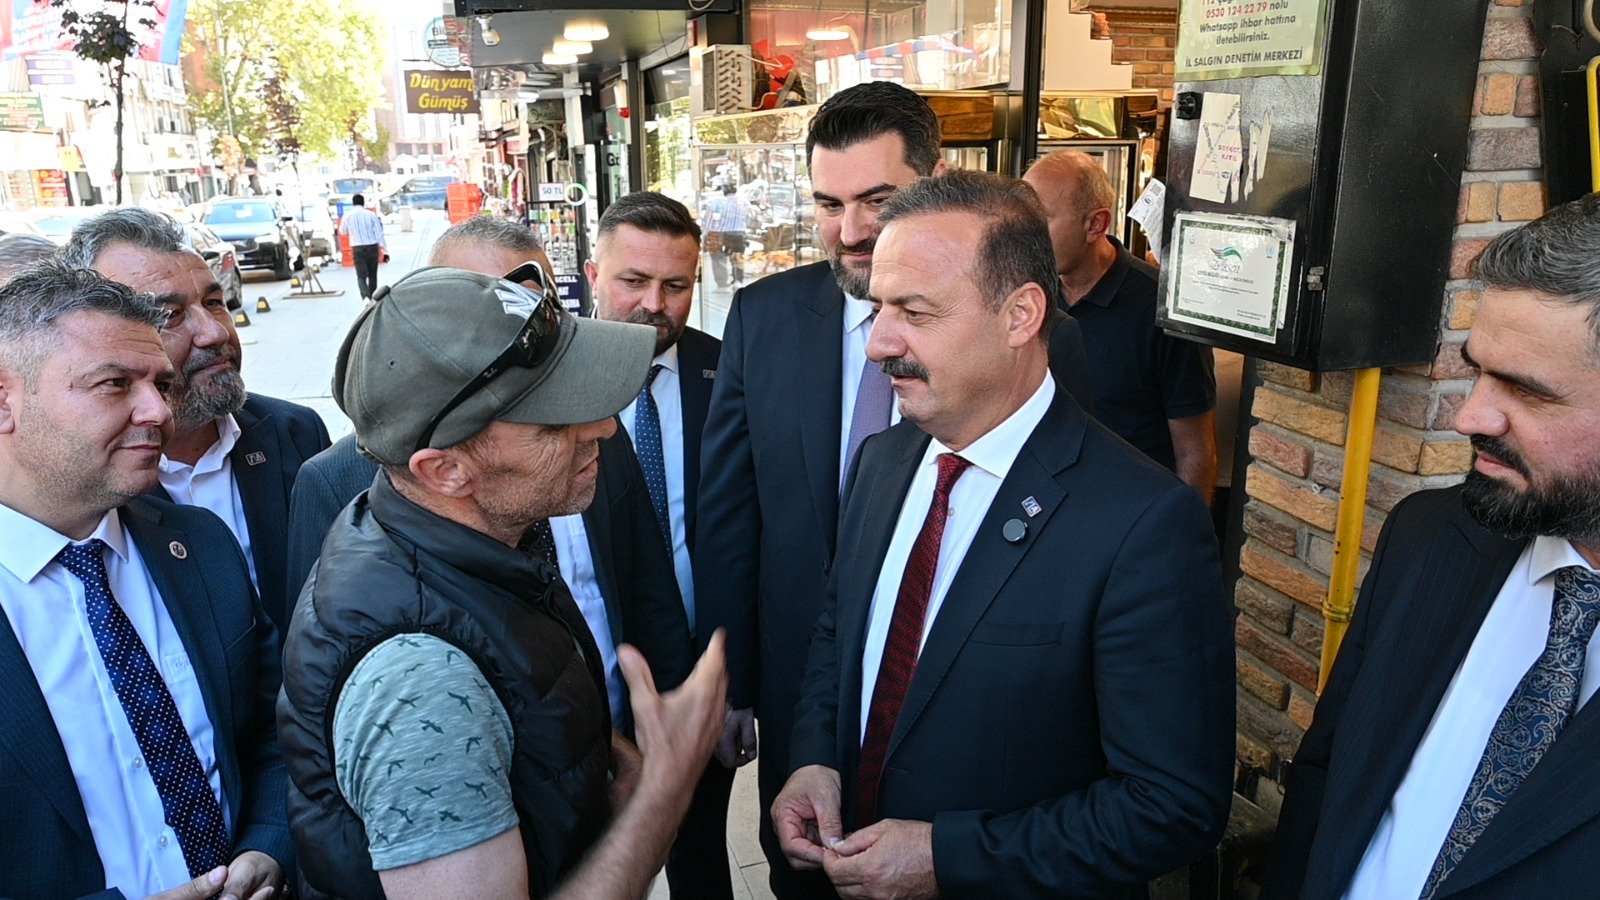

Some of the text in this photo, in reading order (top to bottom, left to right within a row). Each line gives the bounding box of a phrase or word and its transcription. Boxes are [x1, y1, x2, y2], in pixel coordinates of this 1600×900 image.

[1206, 0, 1289, 19] 0530 124 22 79 nolu
[1200, 14, 1296, 34] Whatsapp ihbar hattına
[1186, 46, 1303, 67] İL SALGIN DENETİM MERKEZİ
[419, 93, 468, 111] Gümüş
[542, 187, 552, 195] 50
